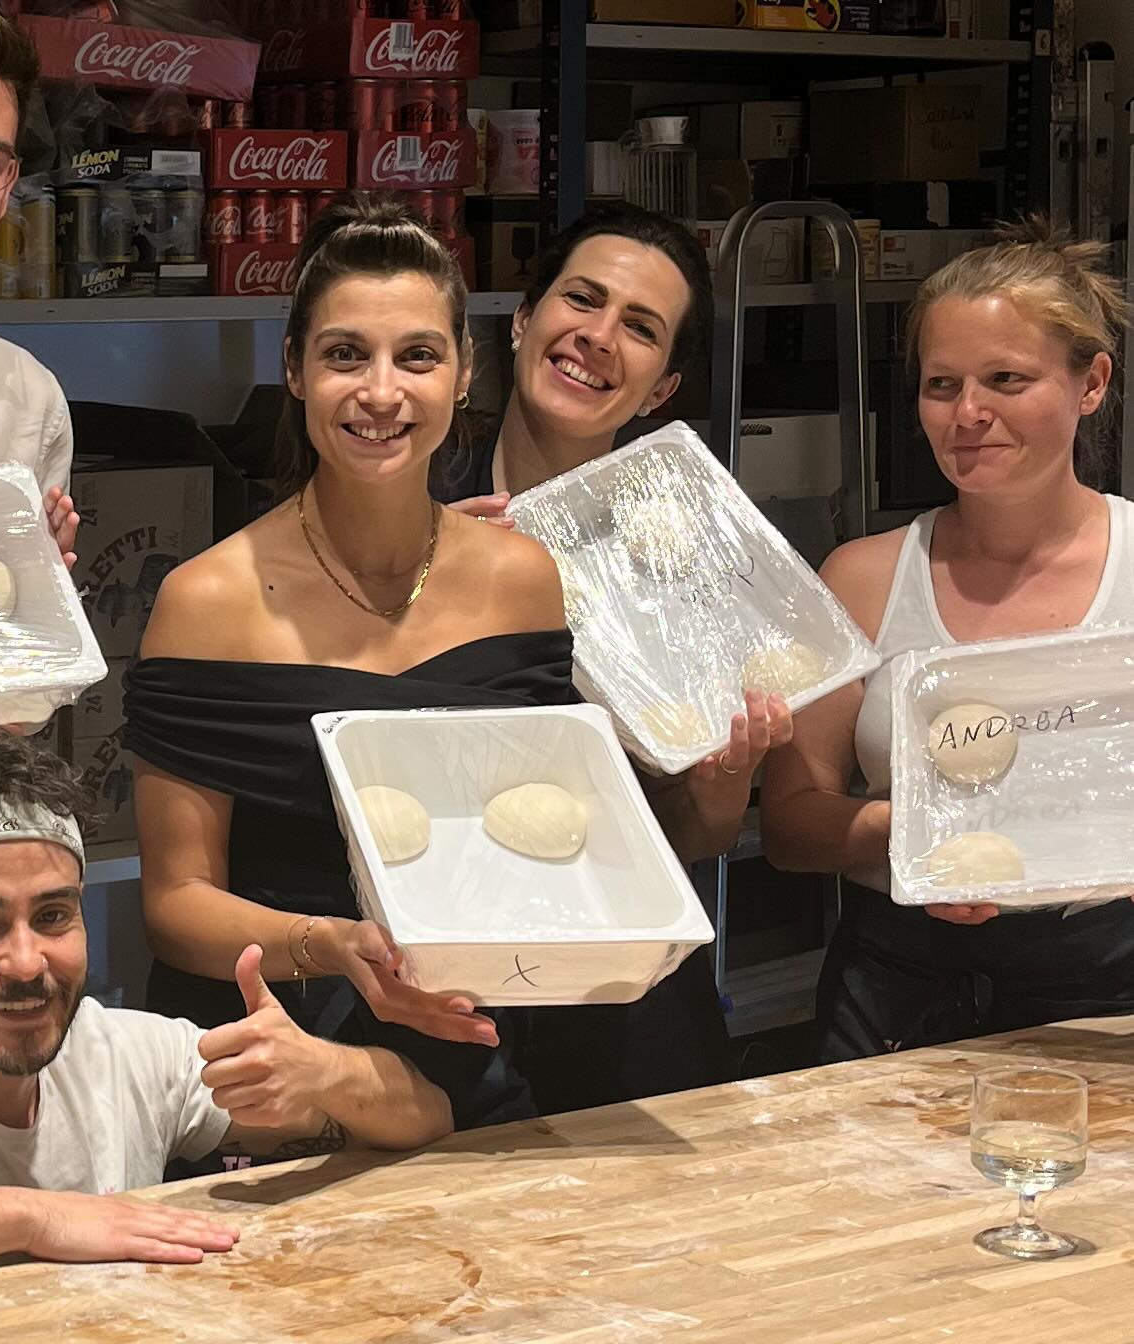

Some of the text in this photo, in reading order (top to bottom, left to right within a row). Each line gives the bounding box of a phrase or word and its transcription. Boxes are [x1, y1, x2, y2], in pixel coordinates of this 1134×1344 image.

[74, 32, 205, 85] Coca-Cola
[71, 149, 121, 169] LEMON
[229, 136, 334, 181] Coca-Cola
[77, 163, 112, 179] SODA
[87, 280, 120, 297] SODA
